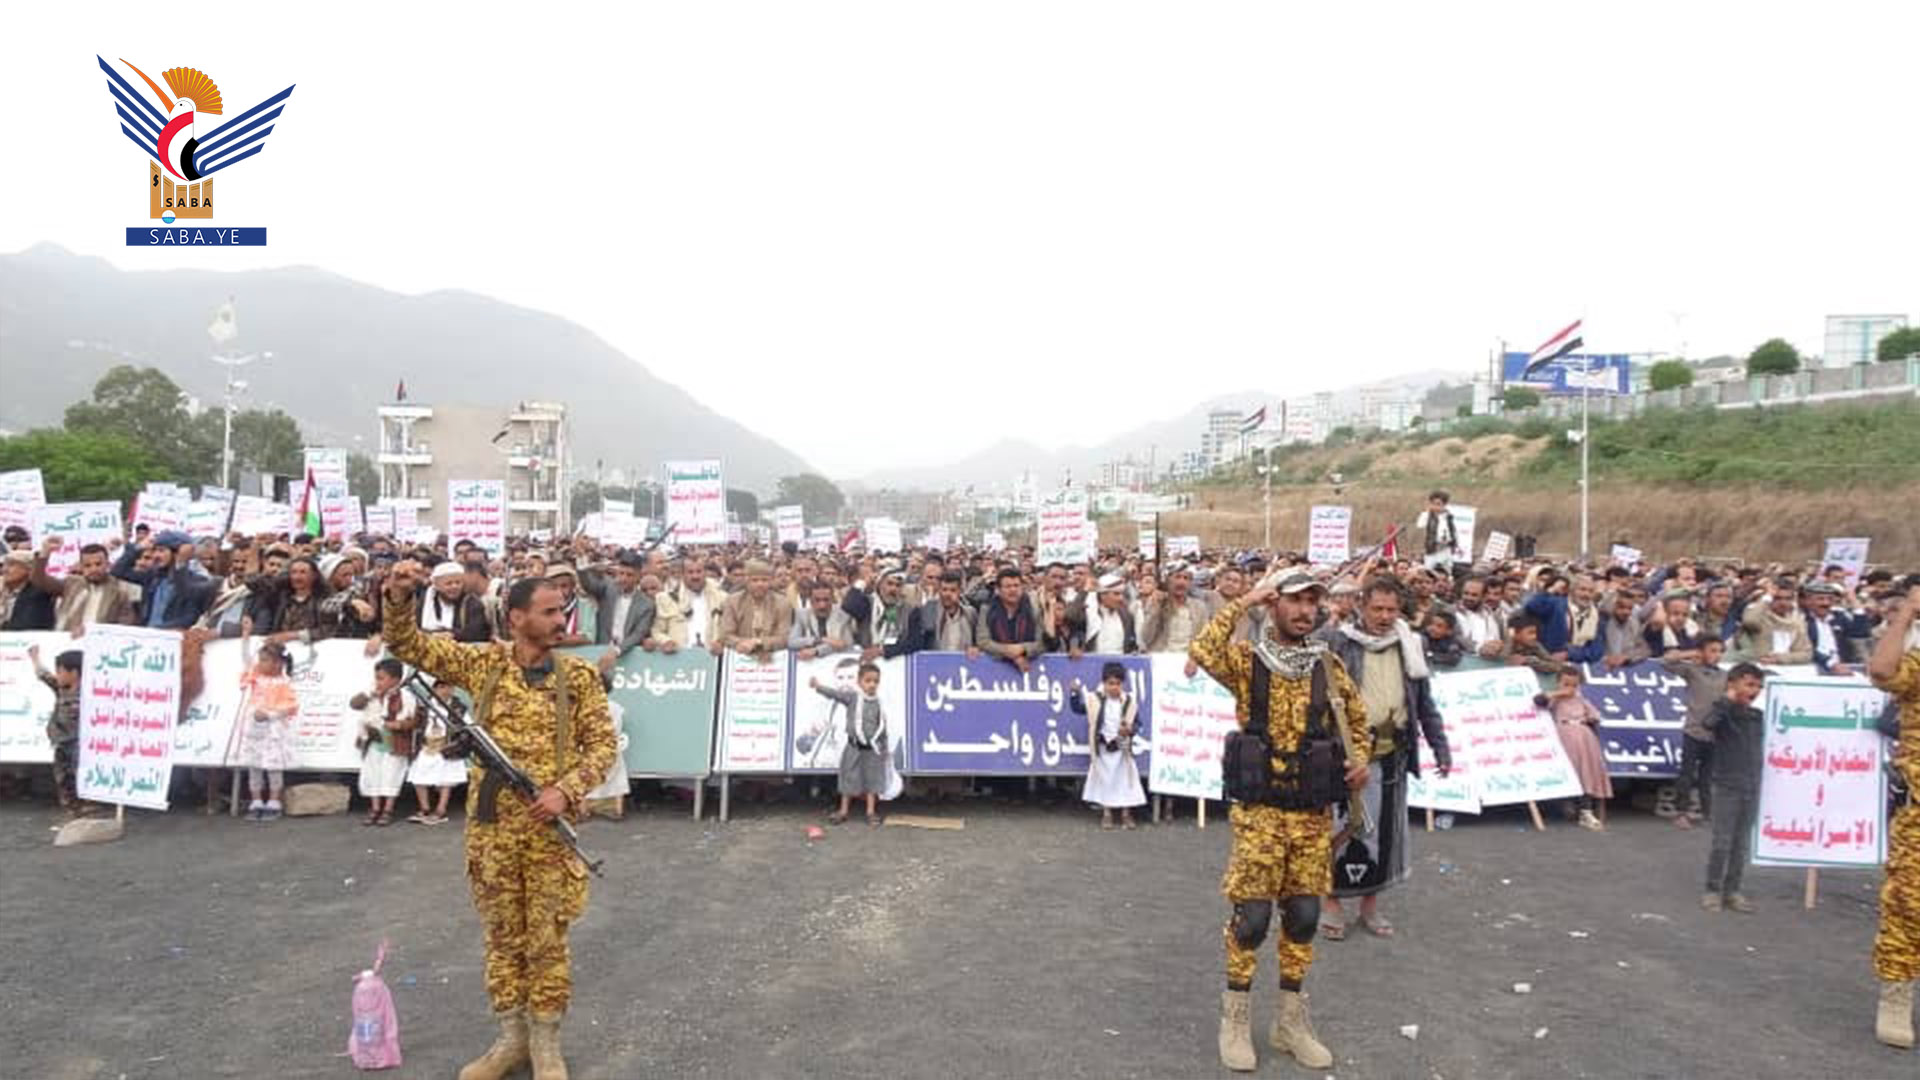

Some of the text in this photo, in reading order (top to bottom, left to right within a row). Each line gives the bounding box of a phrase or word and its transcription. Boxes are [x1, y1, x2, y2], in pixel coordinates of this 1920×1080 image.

[94, 640, 175, 676] الله أكبر
[612, 666, 706, 697] الشهادة
[925, 663, 1064, 713] وفلسطين
[922, 719, 1034, 766] واحد
